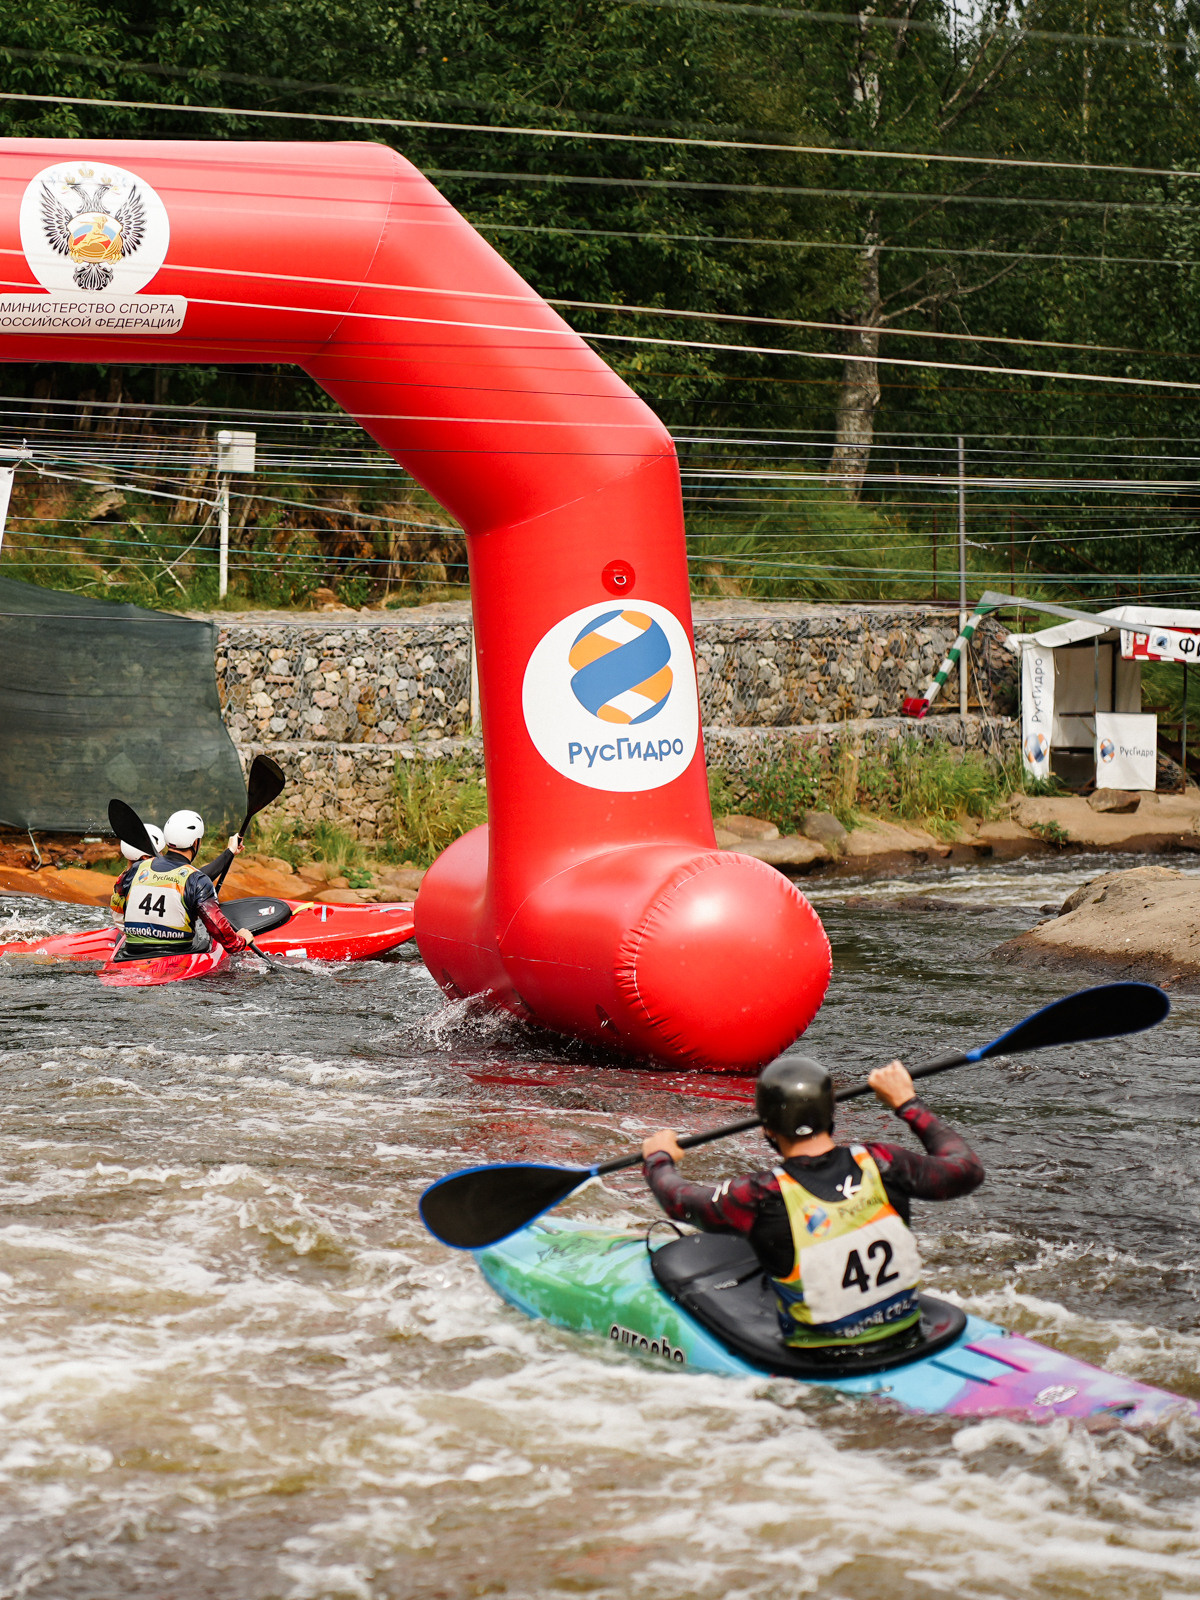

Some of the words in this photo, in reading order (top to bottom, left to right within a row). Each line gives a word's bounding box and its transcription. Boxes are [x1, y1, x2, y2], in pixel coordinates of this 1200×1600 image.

[0, 302, 116, 314] МИНИСТЕРСТВО
[119, 303, 175, 315] СПОРТА
[95, 317, 182, 329] ФЕДЕРАЦИИ
[1031, 658, 1045, 723] РусГидро
[568, 737, 684, 768] РусГидро
[1119, 746, 1154, 758] РусГидро
[138, 893, 166, 918] 44
[152, 928, 185, 939] СЛАЛОМ
[841, 1239, 900, 1294] 42
